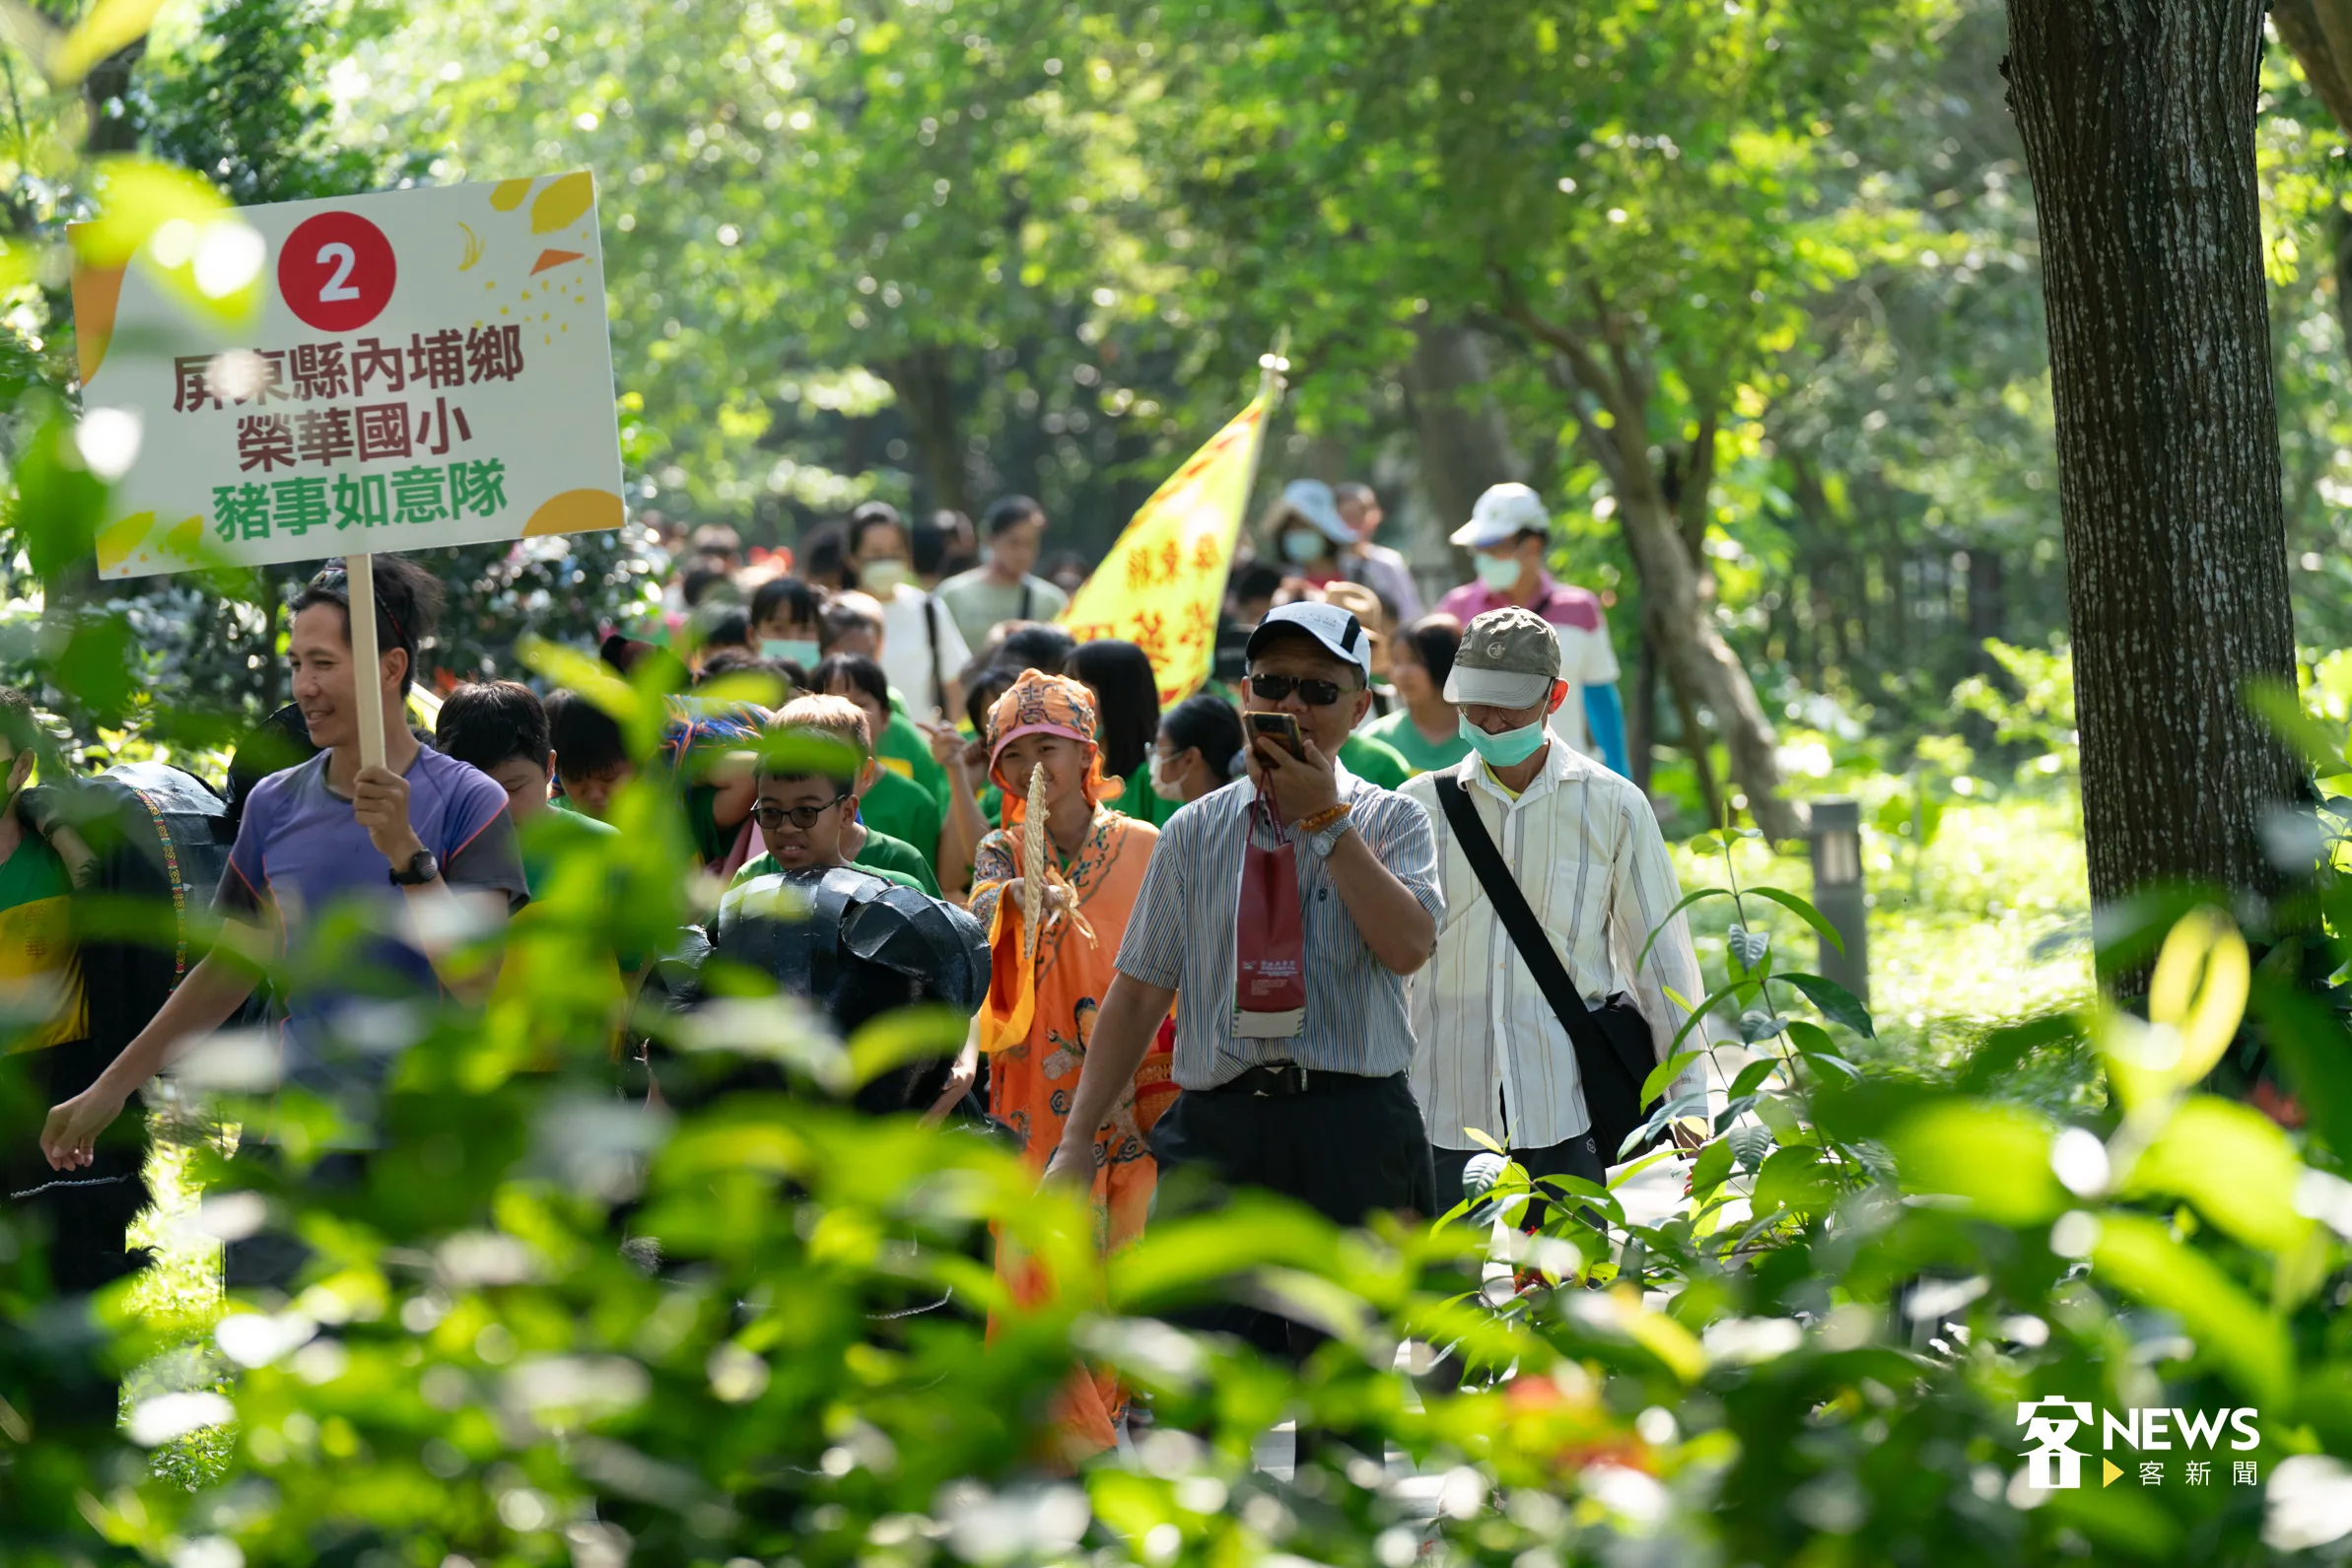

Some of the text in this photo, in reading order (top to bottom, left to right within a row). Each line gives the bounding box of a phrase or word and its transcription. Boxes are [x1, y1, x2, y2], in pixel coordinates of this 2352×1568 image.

[314, 240, 361, 303] 2
[237, 396, 473, 473] 榮華國小
[212, 457, 508, 543] 豬事如意隊
